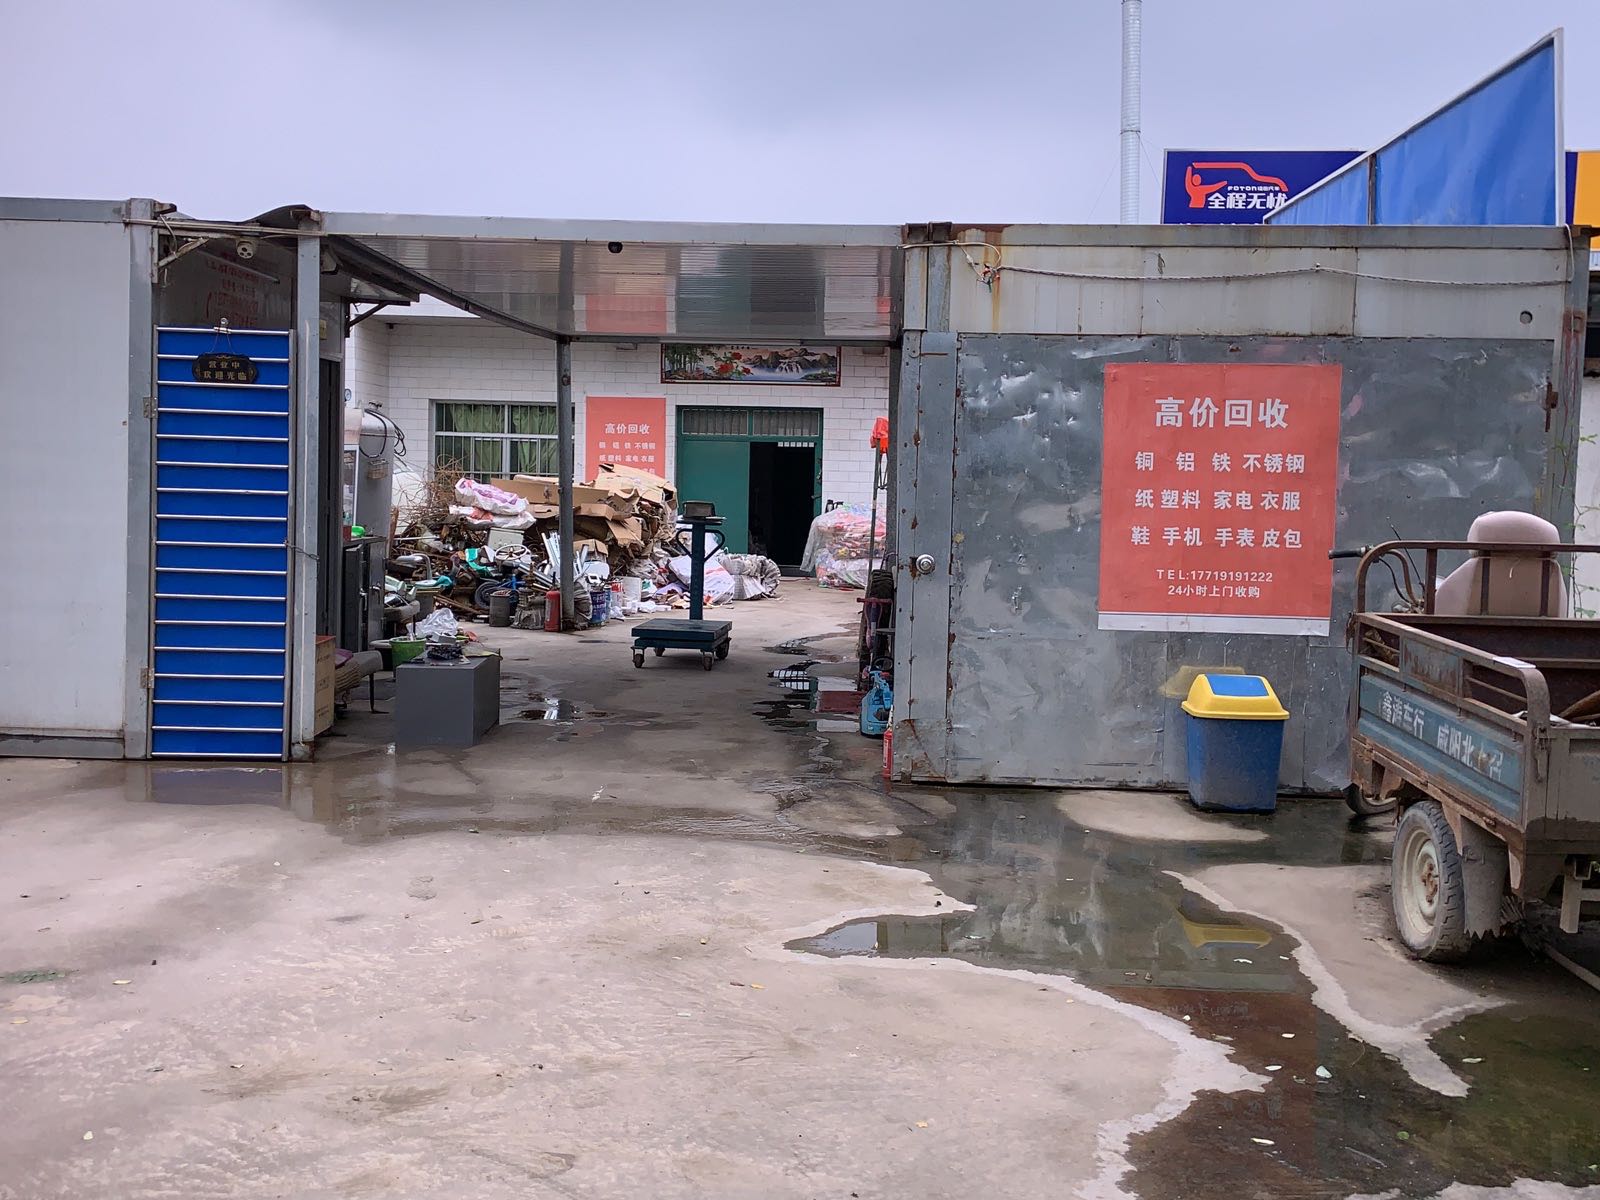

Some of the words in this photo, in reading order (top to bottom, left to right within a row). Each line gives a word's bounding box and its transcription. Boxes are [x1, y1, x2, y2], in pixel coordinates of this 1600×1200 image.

[1208, 192, 1289, 210] 全程无忧
[1155, 397, 1290, 429] 高价回收
[604, 422, 650, 435] 高价回收
[1135, 451, 1154, 472] 铜
[1176, 452, 1195, 473] 铝
[1212, 453, 1231, 473] 铁
[1242, 453, 1305, 474] 不锈钢
[1135, 489, 1154, 509] 纸
[1160, 489, 1201, 509] 塑料
[1213, 490, 1253, 510] 家电
[1260, 491, 1301, 511] 衣服
[1131, 526, 1150, 546] 鞋
[1162, 527, 1202, 547] 手机
[1214, 528, 1255, 548] 手表
[1262, 529, 1302, 549] 皮包
[1167, 585, 1260, 598] 24小时上门收购
